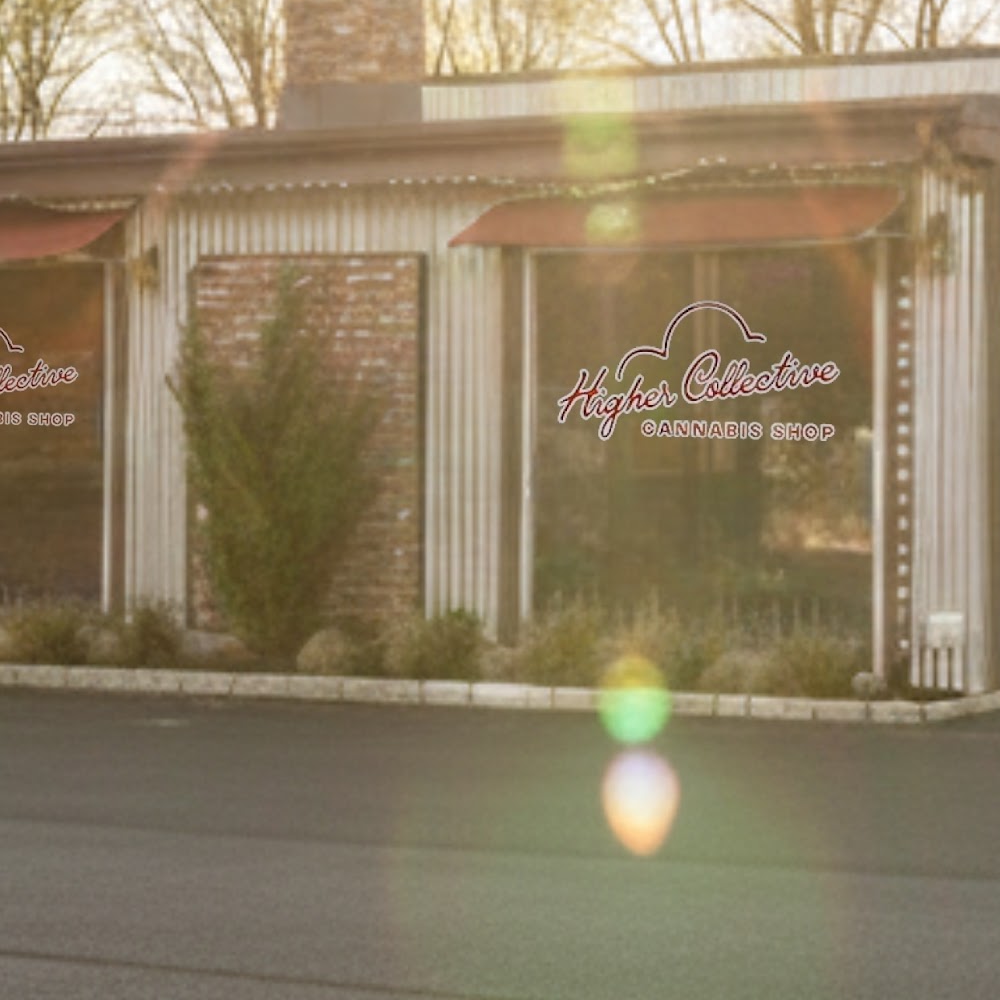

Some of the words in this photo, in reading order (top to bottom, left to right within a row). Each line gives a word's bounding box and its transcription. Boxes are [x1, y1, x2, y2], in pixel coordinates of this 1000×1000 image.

[558, 366, 677, 441] Higher
[682, 349, 840, 403] Collective
[27, 412, 75, 427] SHOP
[641, 419, 763, 439] CANNABIS
[769, 421, 836, 441] SHOP
